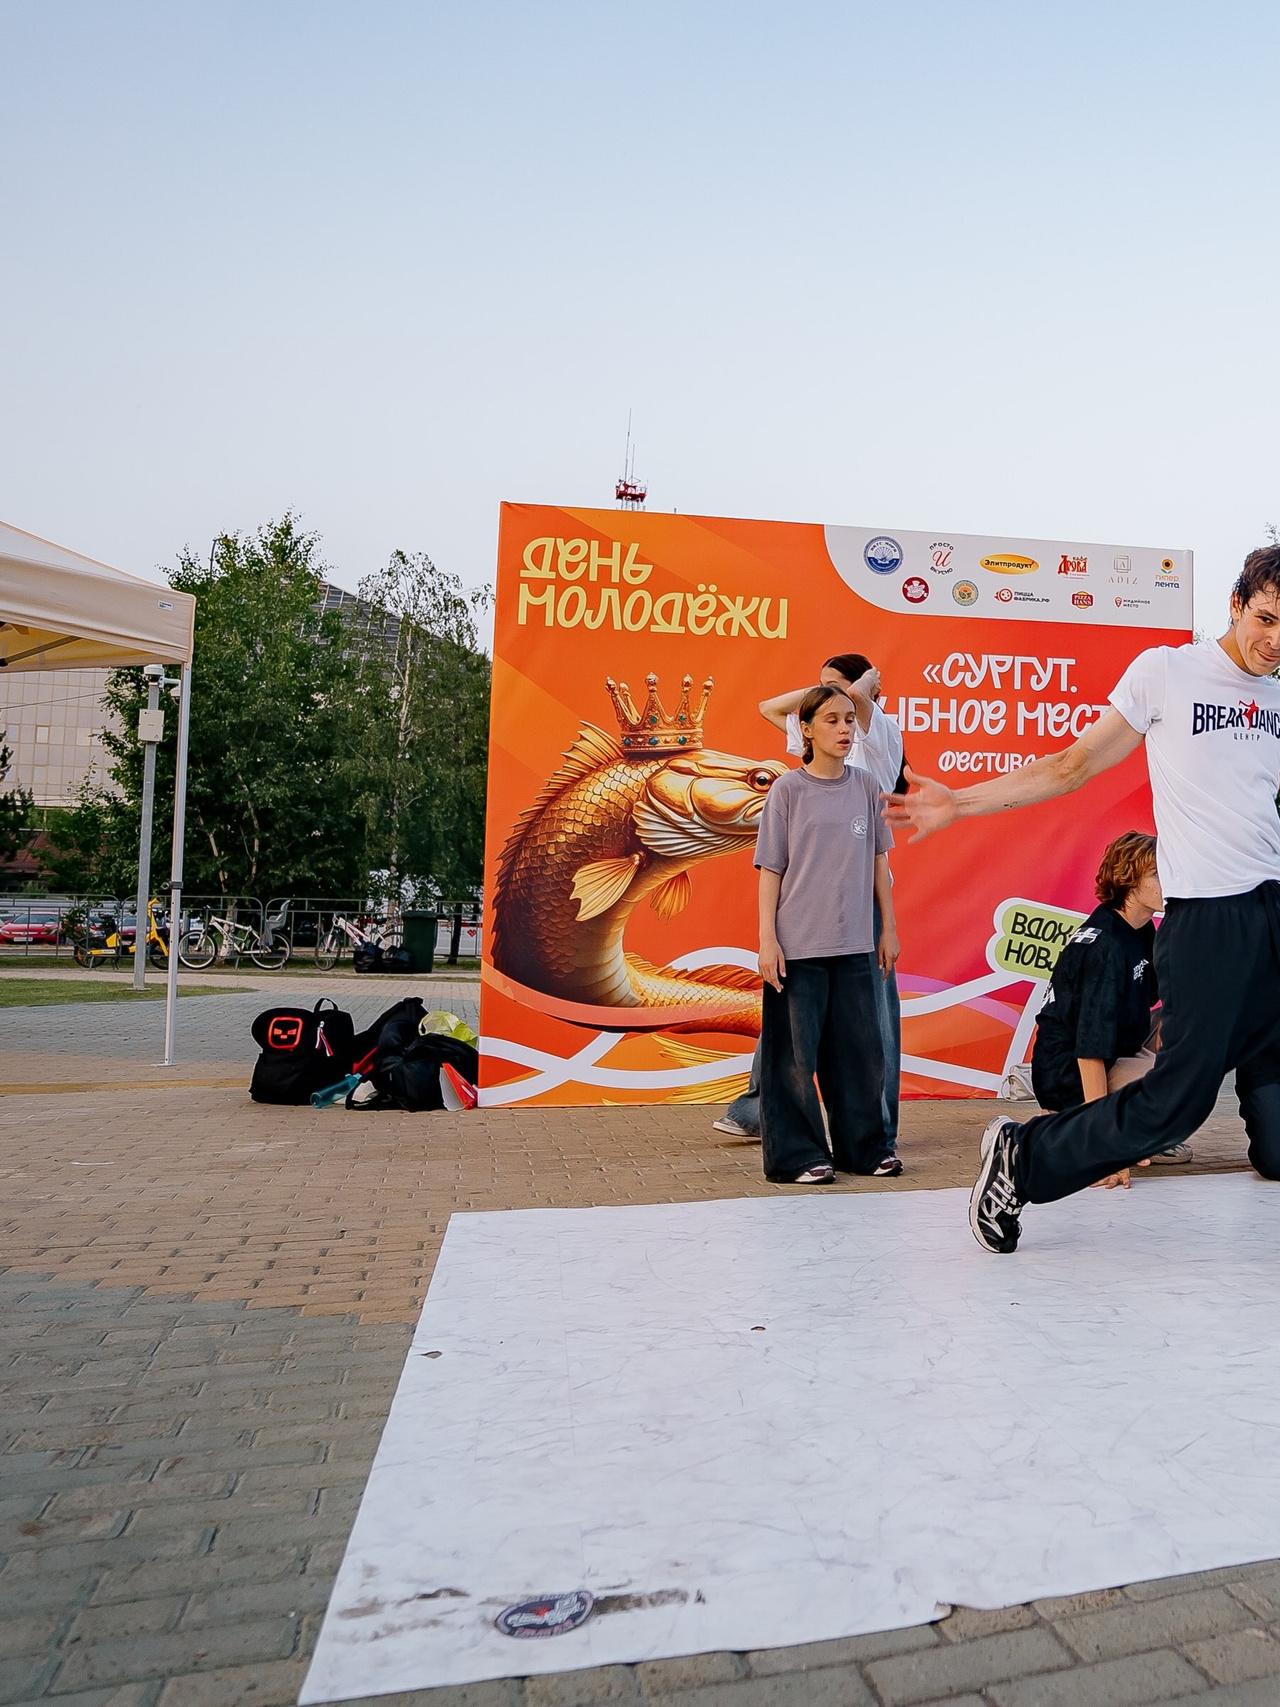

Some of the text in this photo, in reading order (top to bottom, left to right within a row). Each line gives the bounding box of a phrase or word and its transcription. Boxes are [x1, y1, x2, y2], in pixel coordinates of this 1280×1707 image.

[929, 542, 954, 551] ПРОСТО
[519, 536, 654, 585] ДЕНЬ
[984, 559, 1034, 570] Элитпродукт
[1107, 576, 1139, 585] ADIZ
[1155, 574, 1180, 583] гипер
[1154, 581, 1180, 589] лента
[517, 583, 789, 640] МОЛОДЁЖИ
[878, 695, 1111, 739] ЫБНОЕ МЕСТ
[1233, 732, 1261, 742] ЦЕНТР
